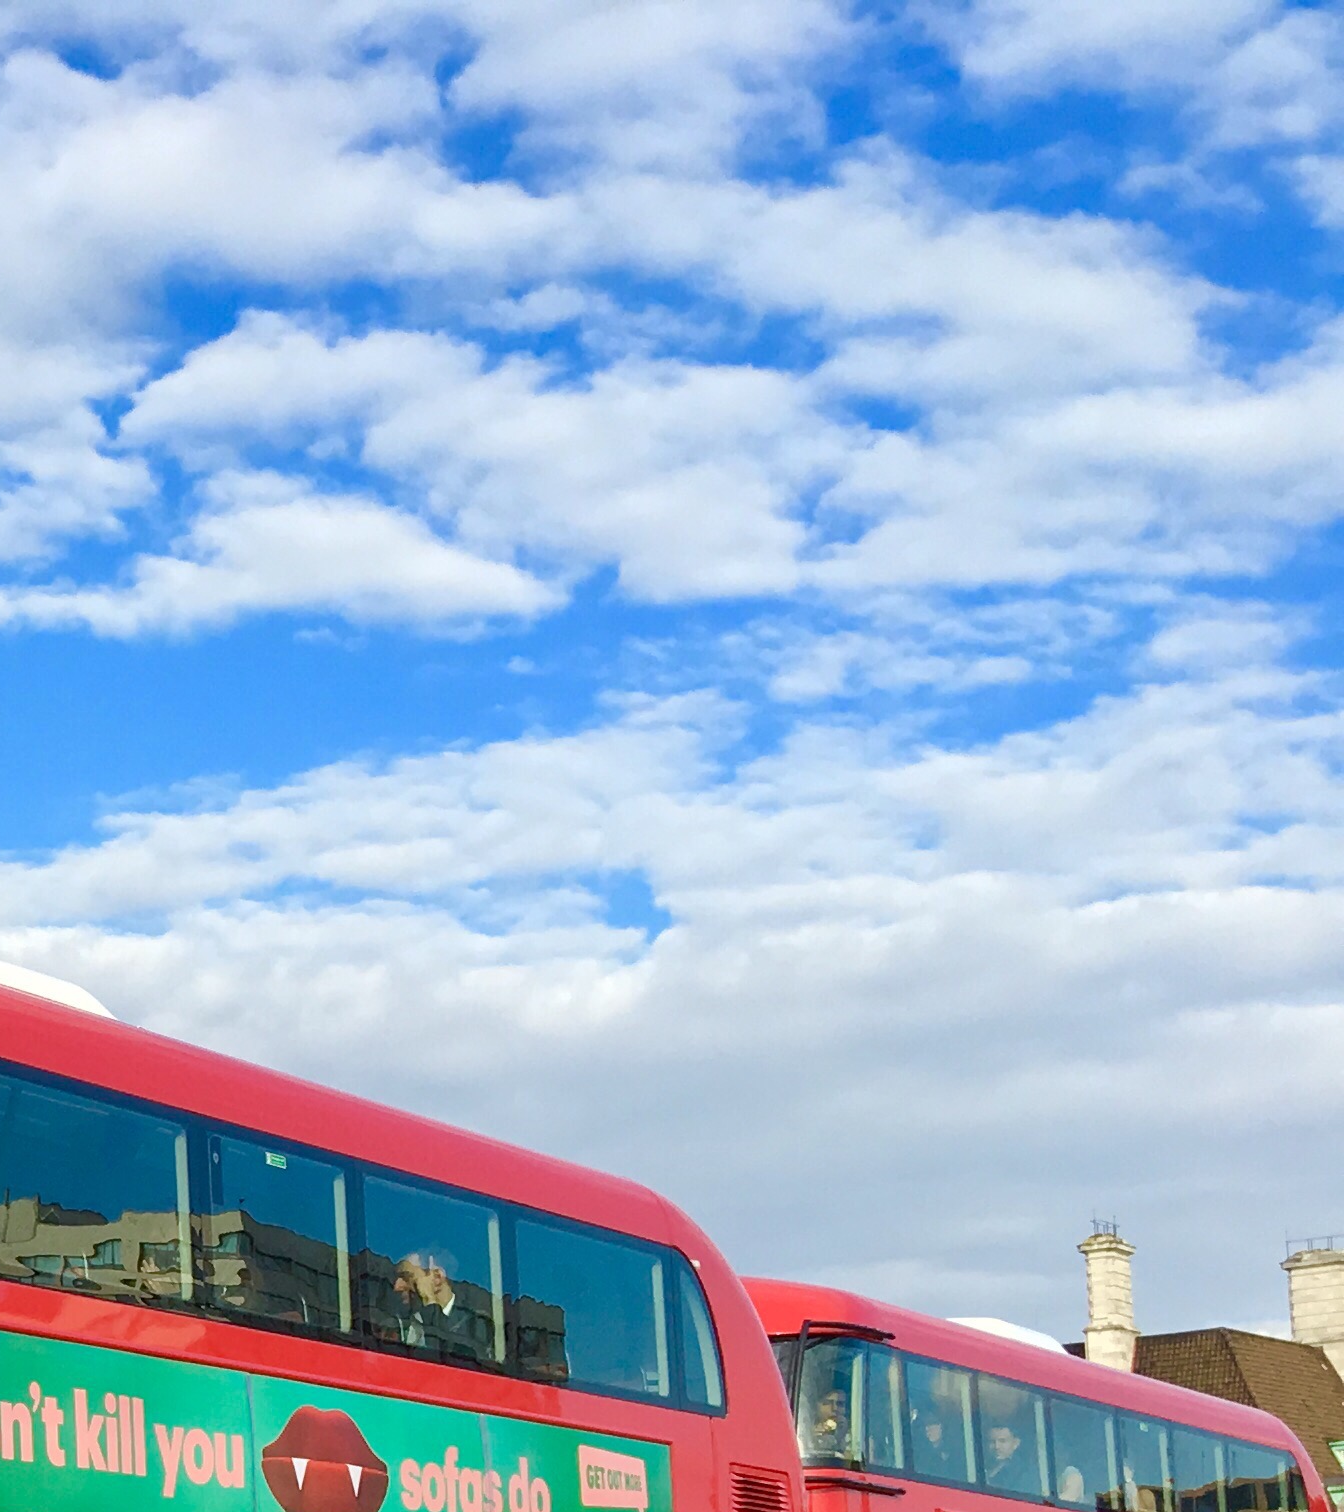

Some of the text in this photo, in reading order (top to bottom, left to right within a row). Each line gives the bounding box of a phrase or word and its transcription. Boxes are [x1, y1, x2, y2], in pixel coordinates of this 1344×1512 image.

[73, 1387, 147, 1477] kill
[154, 1423, 245, 1498] you
[586, 1464, 606, 1490] GET
[607, 1469, 623, 1490] OUT
